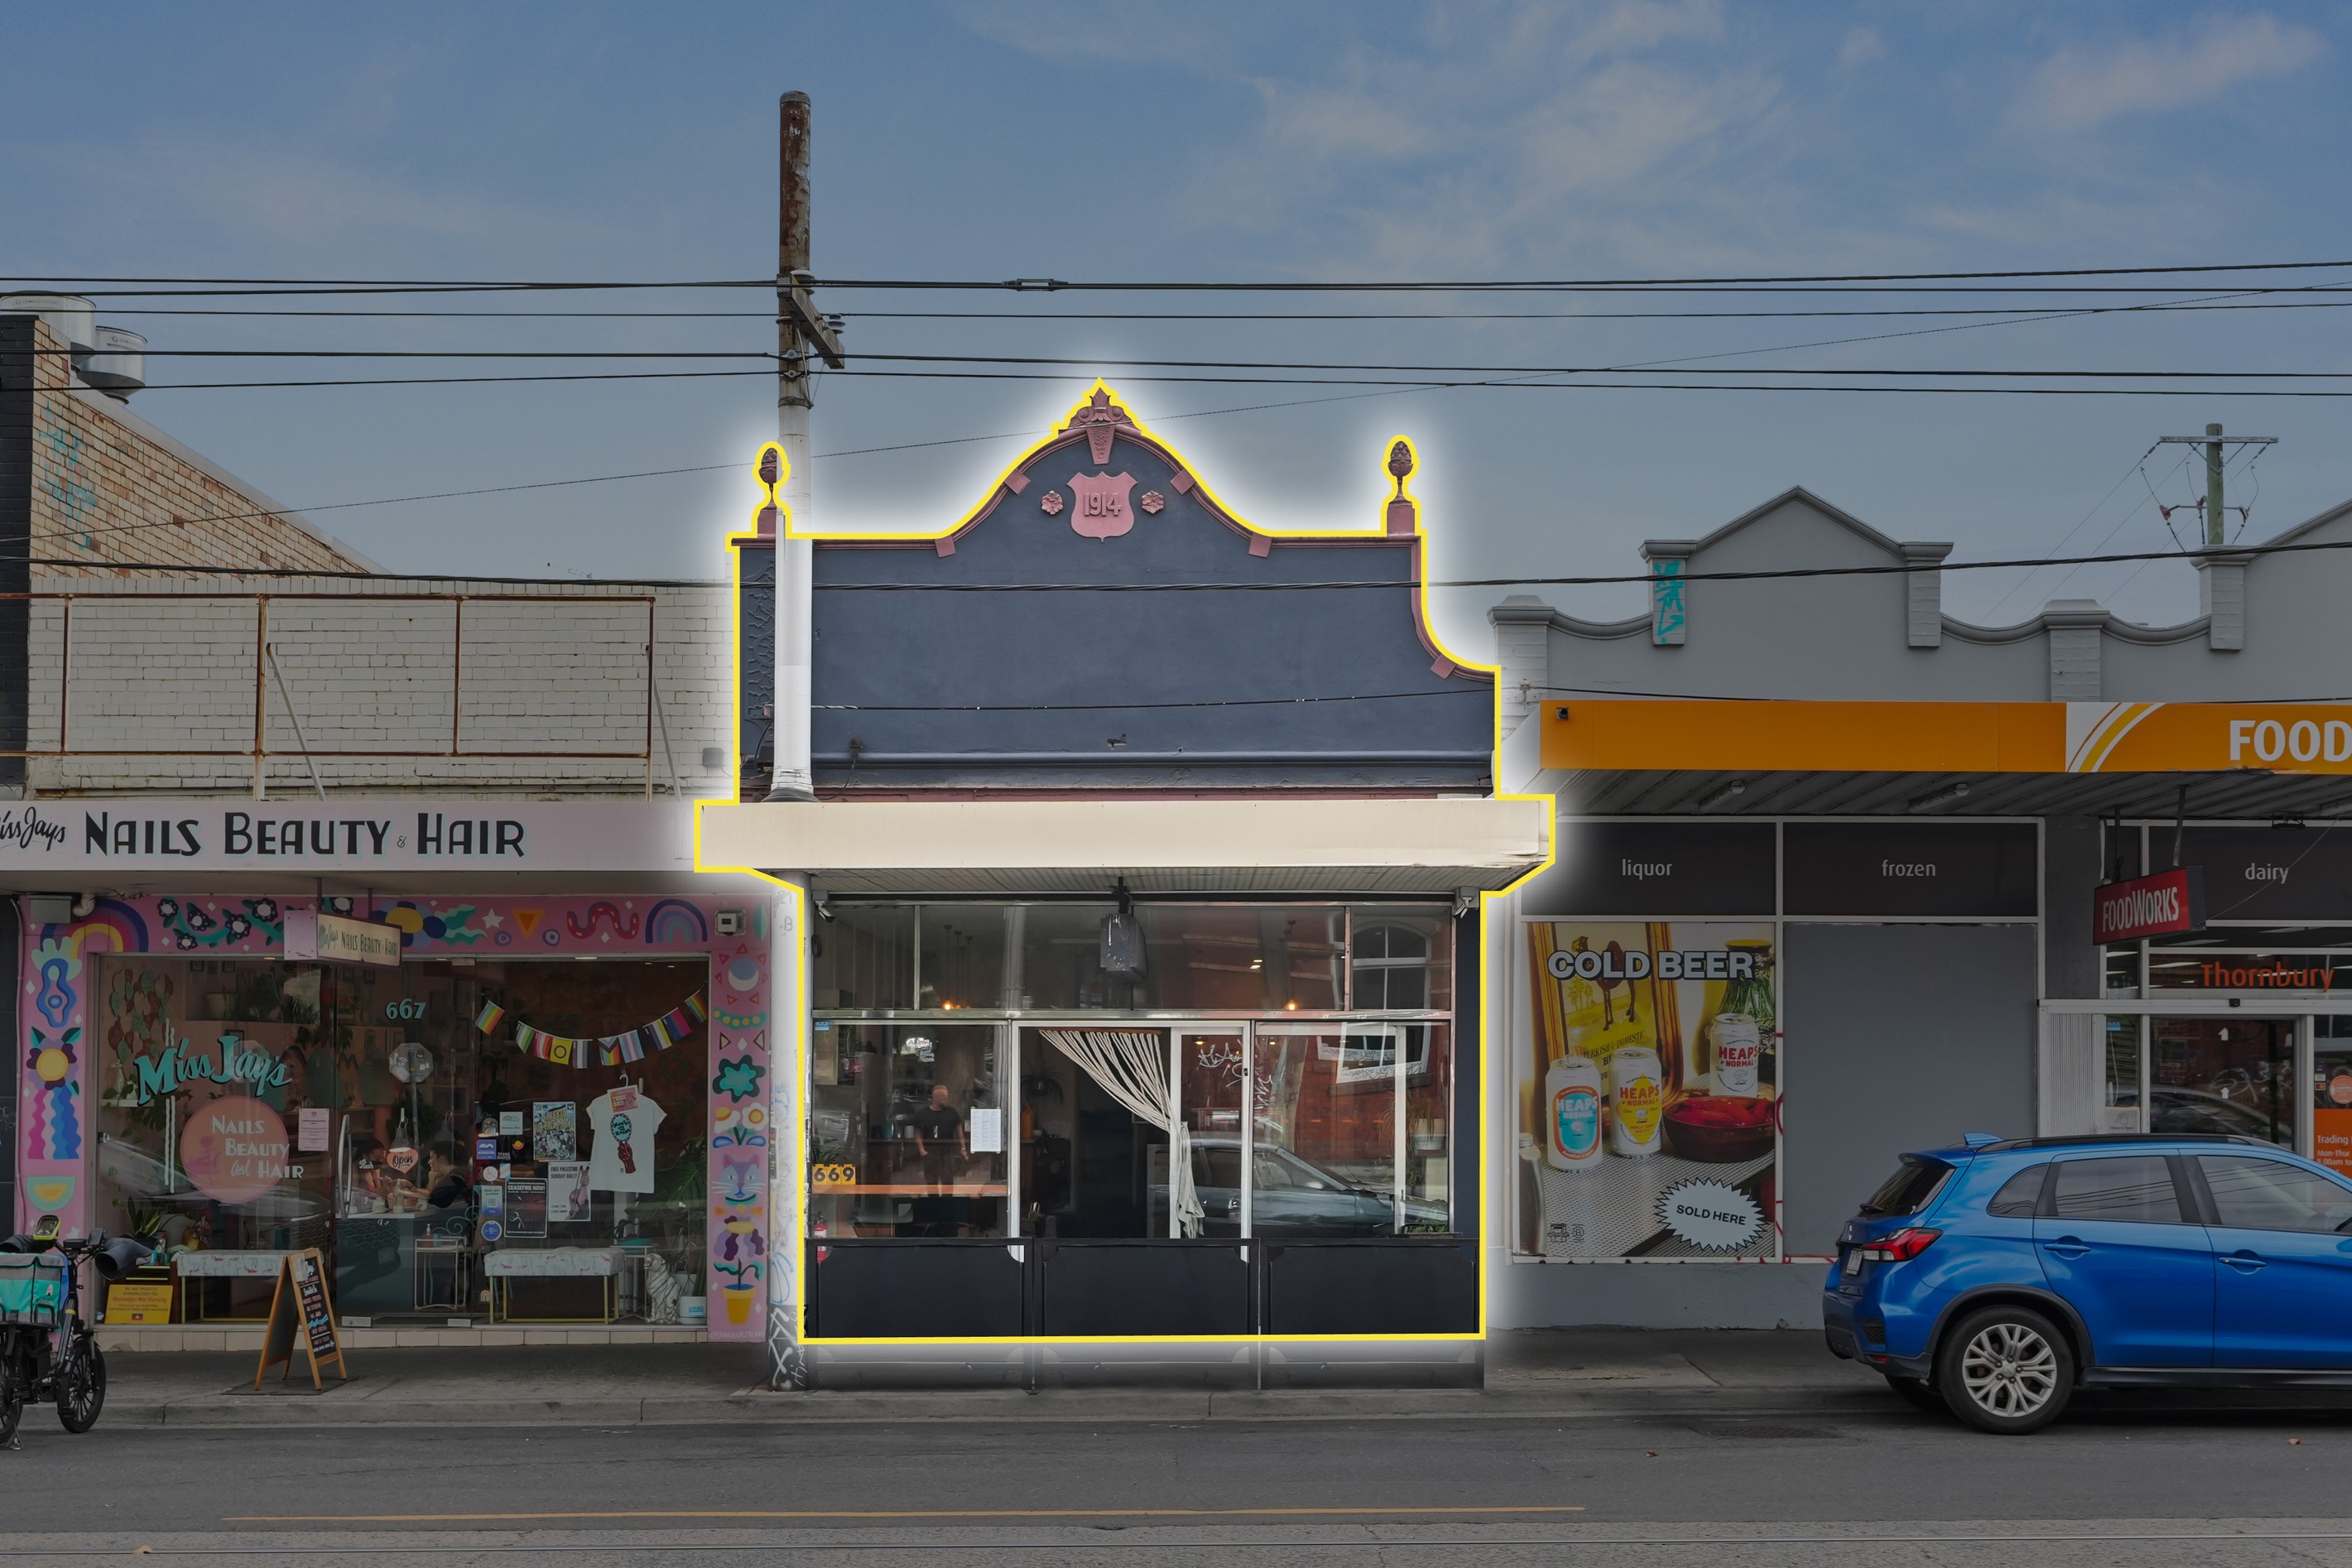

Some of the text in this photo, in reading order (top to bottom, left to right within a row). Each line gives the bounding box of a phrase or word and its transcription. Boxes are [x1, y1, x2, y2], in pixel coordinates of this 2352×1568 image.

[1085, 493, 1122, 517] 1914
[2229, 719, 2352, 762] FOOD
[0, 806, 525, 857] iss Jays NAILS BEAUTY & HAIR
[1623, 859, 1672, 880] liquor
[1881, 859, 1936, 877] frozen
[2245, 862, 2288, 884] dairy
[341, 931, 358, 951] NAILS
[360, 933, 382, 955] BEAUTY
[385, 937, 397, 956] HAIR
[1547, 950, 1755, 980] COLD BEER
[2200, 960, 2335, 993] Thornbury
[385, 998, 426, 1020] 667
[1583, 1042, 1610, 1059] TURKISH
[1718, 1045, 1758, 1060] HEAPS
[133, 1035, 293, 1107] Miss Jay's
[1619, 1084, 1660, 1099] HEAPS
[1556, 1095, 1599, 1112] HEAPS
[212, 1114, 265, 1136] NAILS
[224, 1138, 291, 1160] BEAUTY
[2316, 1134, 2349, 1146] Trading
[257, 1160, 304, 1179] HAIR
[392, 1155, 413, 1168] Open
[814, 1167, 854, 1181] 669
[1676, 1205, 1746, 1225] SOLD HERE
